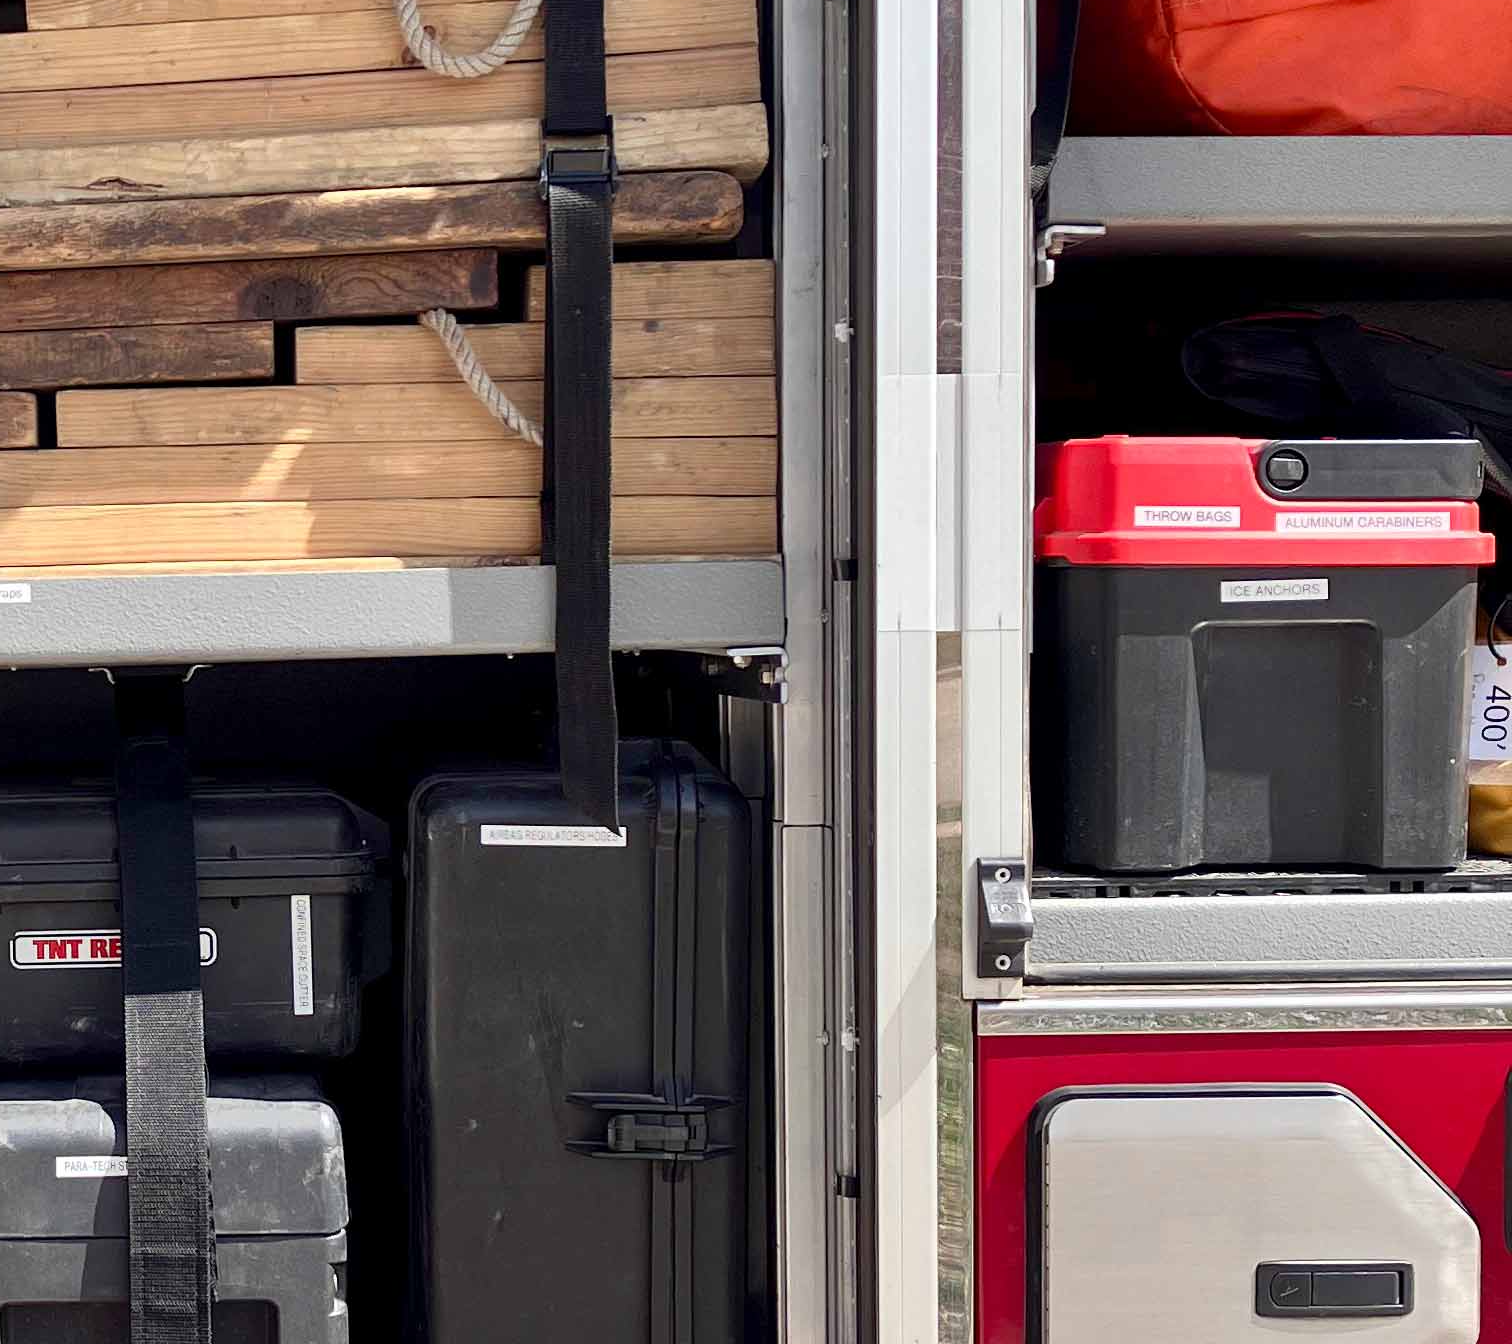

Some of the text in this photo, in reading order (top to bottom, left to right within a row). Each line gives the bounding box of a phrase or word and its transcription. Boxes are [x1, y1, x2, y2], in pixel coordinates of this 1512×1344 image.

[1144, 510, 1233, 523] THROW BAGS
[1285, 516, 1443, 528] ALUMINUM CARABINERS
[1230, 583, 1321, 598] ICE ANCHORS
[33, 939, 82, 960] TNT
